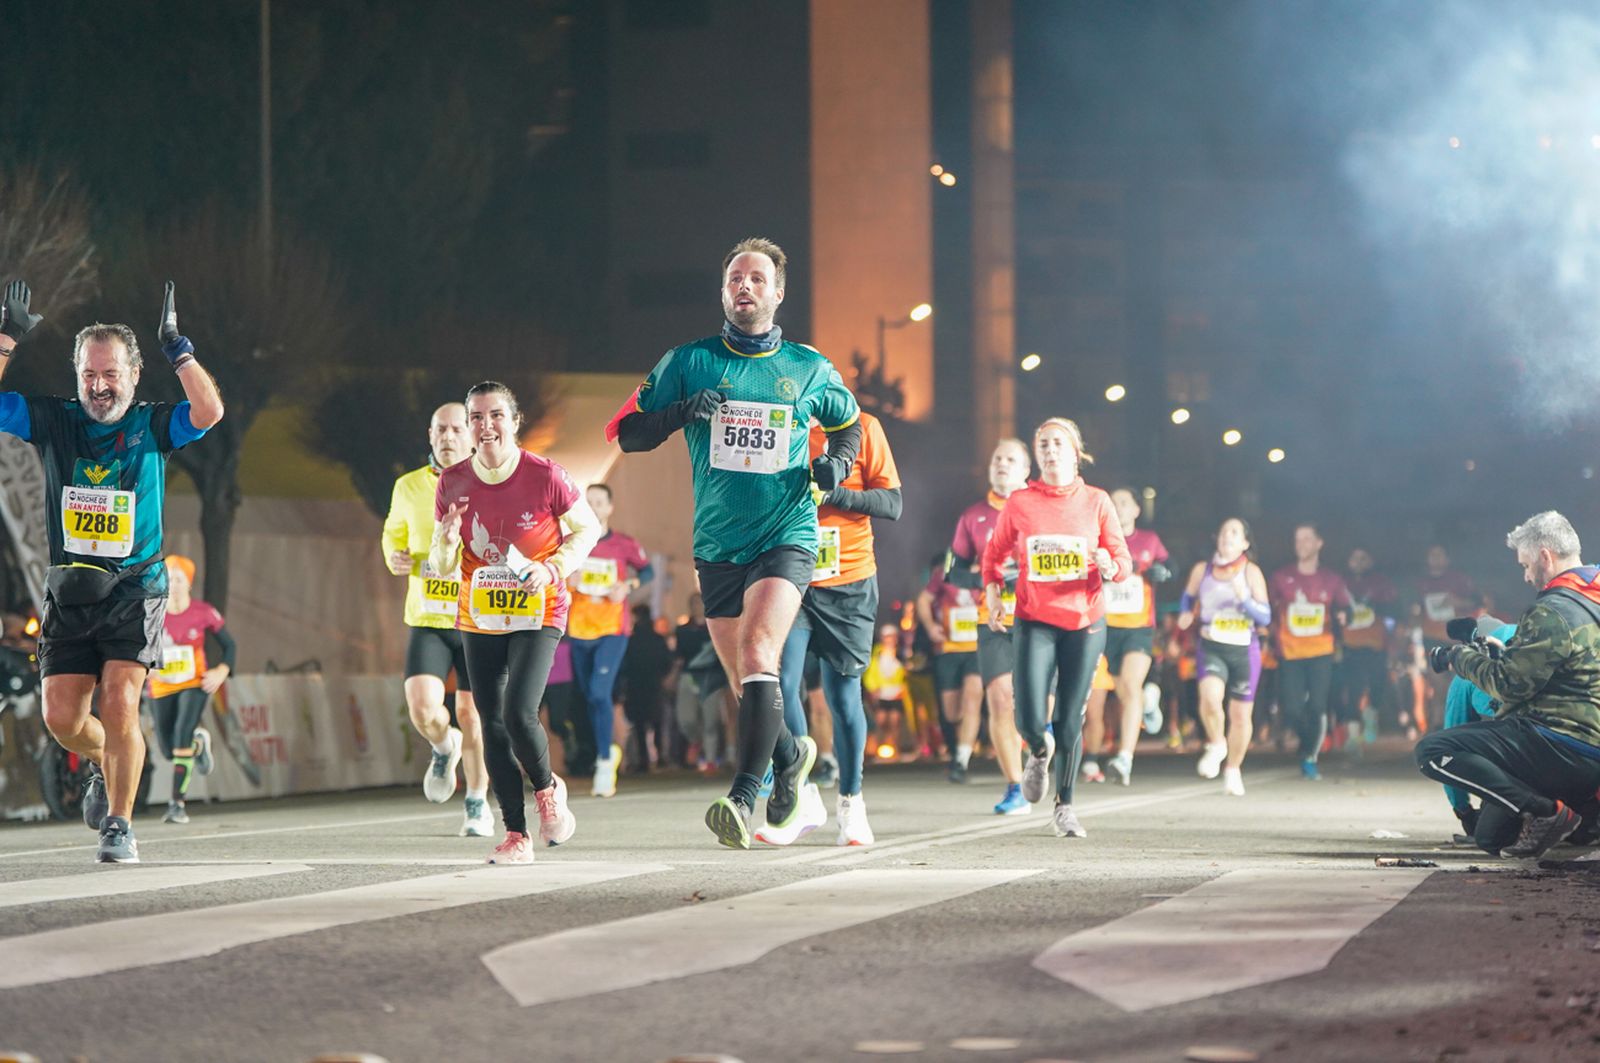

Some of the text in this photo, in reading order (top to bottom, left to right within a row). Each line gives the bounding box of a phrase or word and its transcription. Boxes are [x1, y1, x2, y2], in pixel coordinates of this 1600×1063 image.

[730, 409, 752, 417] NOCHE
[720, 416, 735, 424] SAN
[724, 425, 776, 450] 5833
[77, 495, 98, 504] NOCHE
[98, 497, 107, 505] DE
[69, 502, 82, 510] SAN
[74, 512, 119, 534] 7288
[1037, 554, 1080, 570] 13044
[477, 581, 493, 589] SAN
[486, 589, 528, 609] 1972
